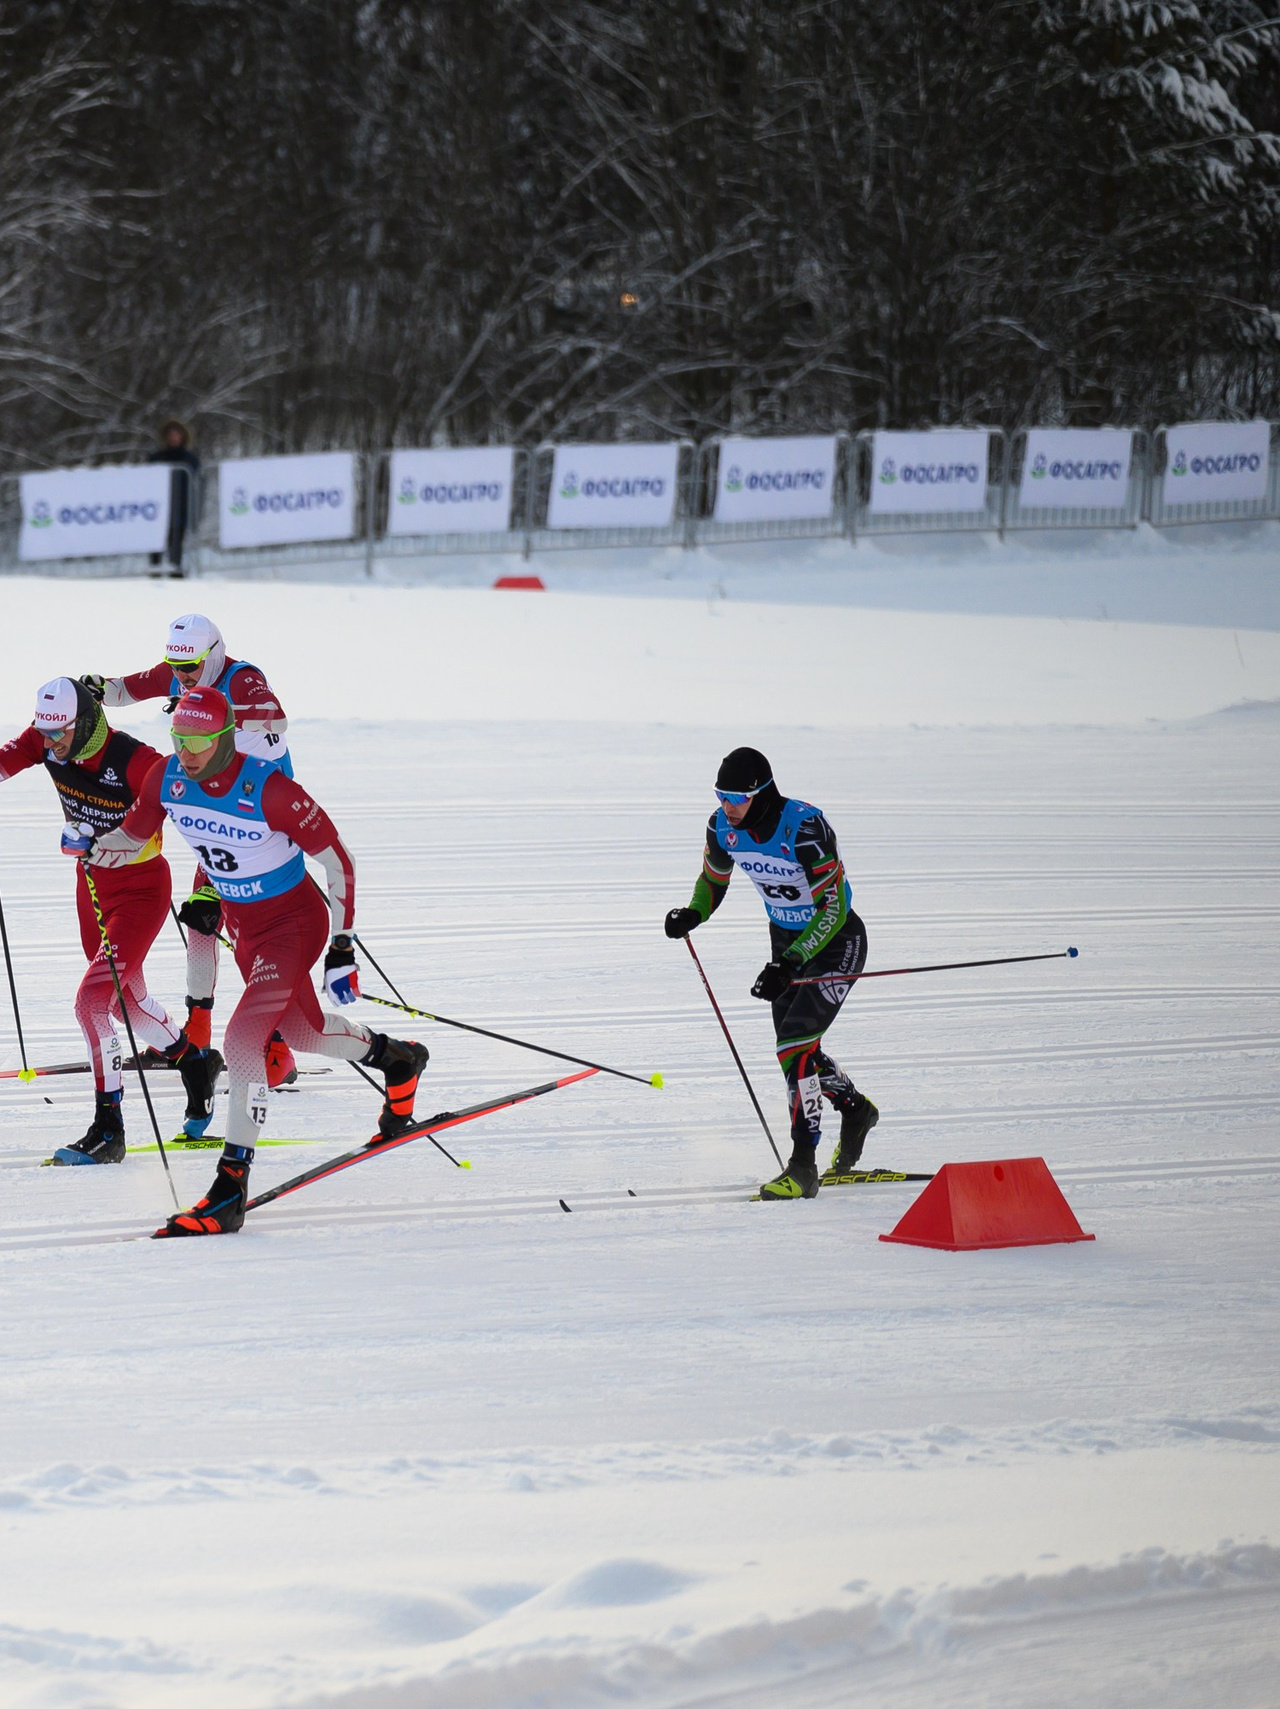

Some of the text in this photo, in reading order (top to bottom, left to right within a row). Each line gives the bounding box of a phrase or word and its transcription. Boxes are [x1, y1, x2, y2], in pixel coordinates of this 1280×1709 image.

[901, 464, 979, 484] ФОСАГРО
[1050, 460, 1122, 480] ФОСАГРО
[1191, 455, 1260, 475] ФОСАГРО
[581, 478, 665, 497] ФОСАГРО
[746, 471, 824, 491] ФОСАГРО
[254, 490, 342, 512] ФОСАГРО
[421, 483, 500, 503] ФОСАГРО
[58, 501, 158, 524] ФОСАГРО
[87, 795, 125, 809] СТРАНА
[180, 816, 262, 841] ФОСАГРО
[193, 845, 239, 873] 13
[838, 940, 853, 972] Сетевая
[112, 1055, 122, 1071] 8
[251, 1106, 267, 1124] 13
[804, 1094, 824, 1116] 28
[184, 1141, 223, 1150] FISCHER
[820, 1173, 907, 1187] FISCHER
